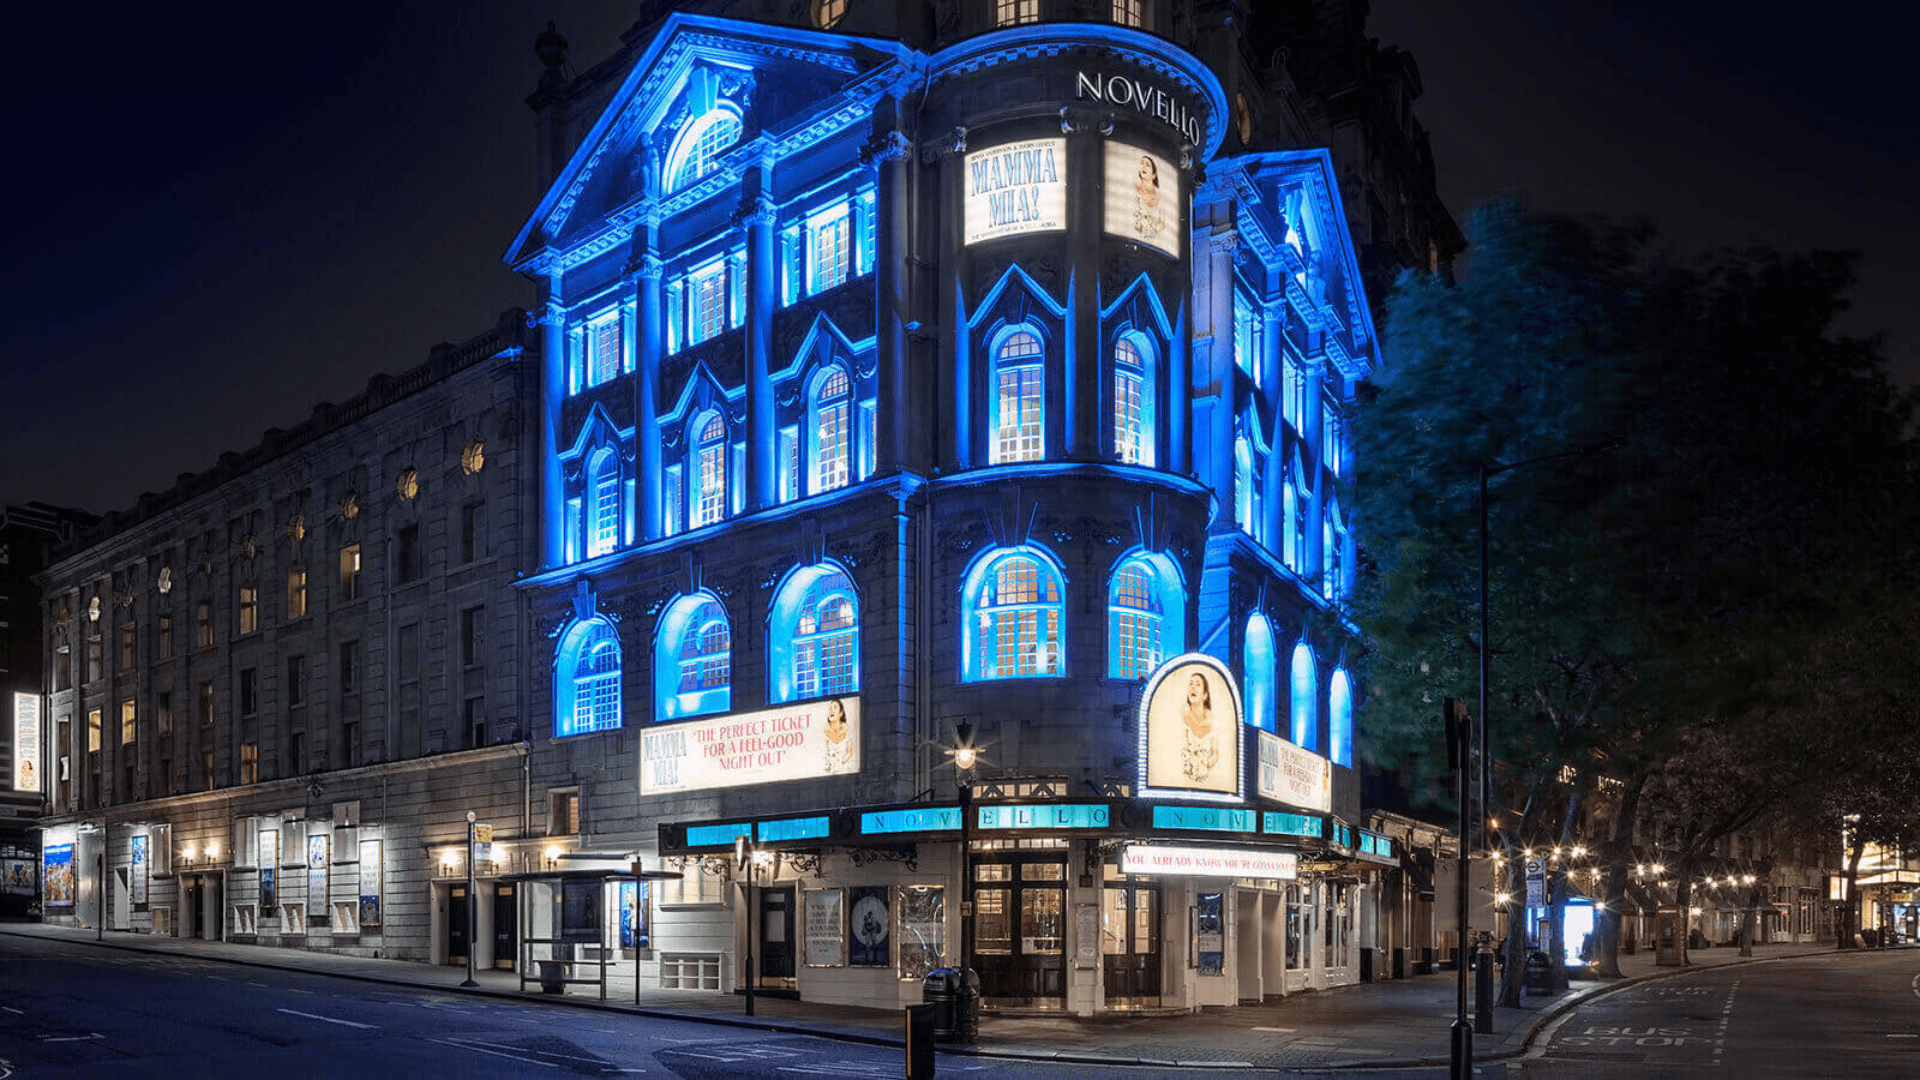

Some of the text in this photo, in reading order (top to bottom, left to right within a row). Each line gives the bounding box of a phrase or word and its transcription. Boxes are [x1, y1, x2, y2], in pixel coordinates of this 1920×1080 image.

[1078, 71, 1200, 146] NOVELLO
[971, 148, 1057, 197] MAMMA
[988, 185, 1039, 229] MIA!
[719, 720, 765, 740] PERFECT
[770, 713, 811, 733] TICKET
[703, 731, 804, 758] FOR A FEEL-GOOD
[719, 754, 753, 770] NIGHT
[1152, 856, 1192, 866] ALREADY
[1558, 1037, 1712, 1046] STOP
[1583, 1026, 1693, 1036] BUS
